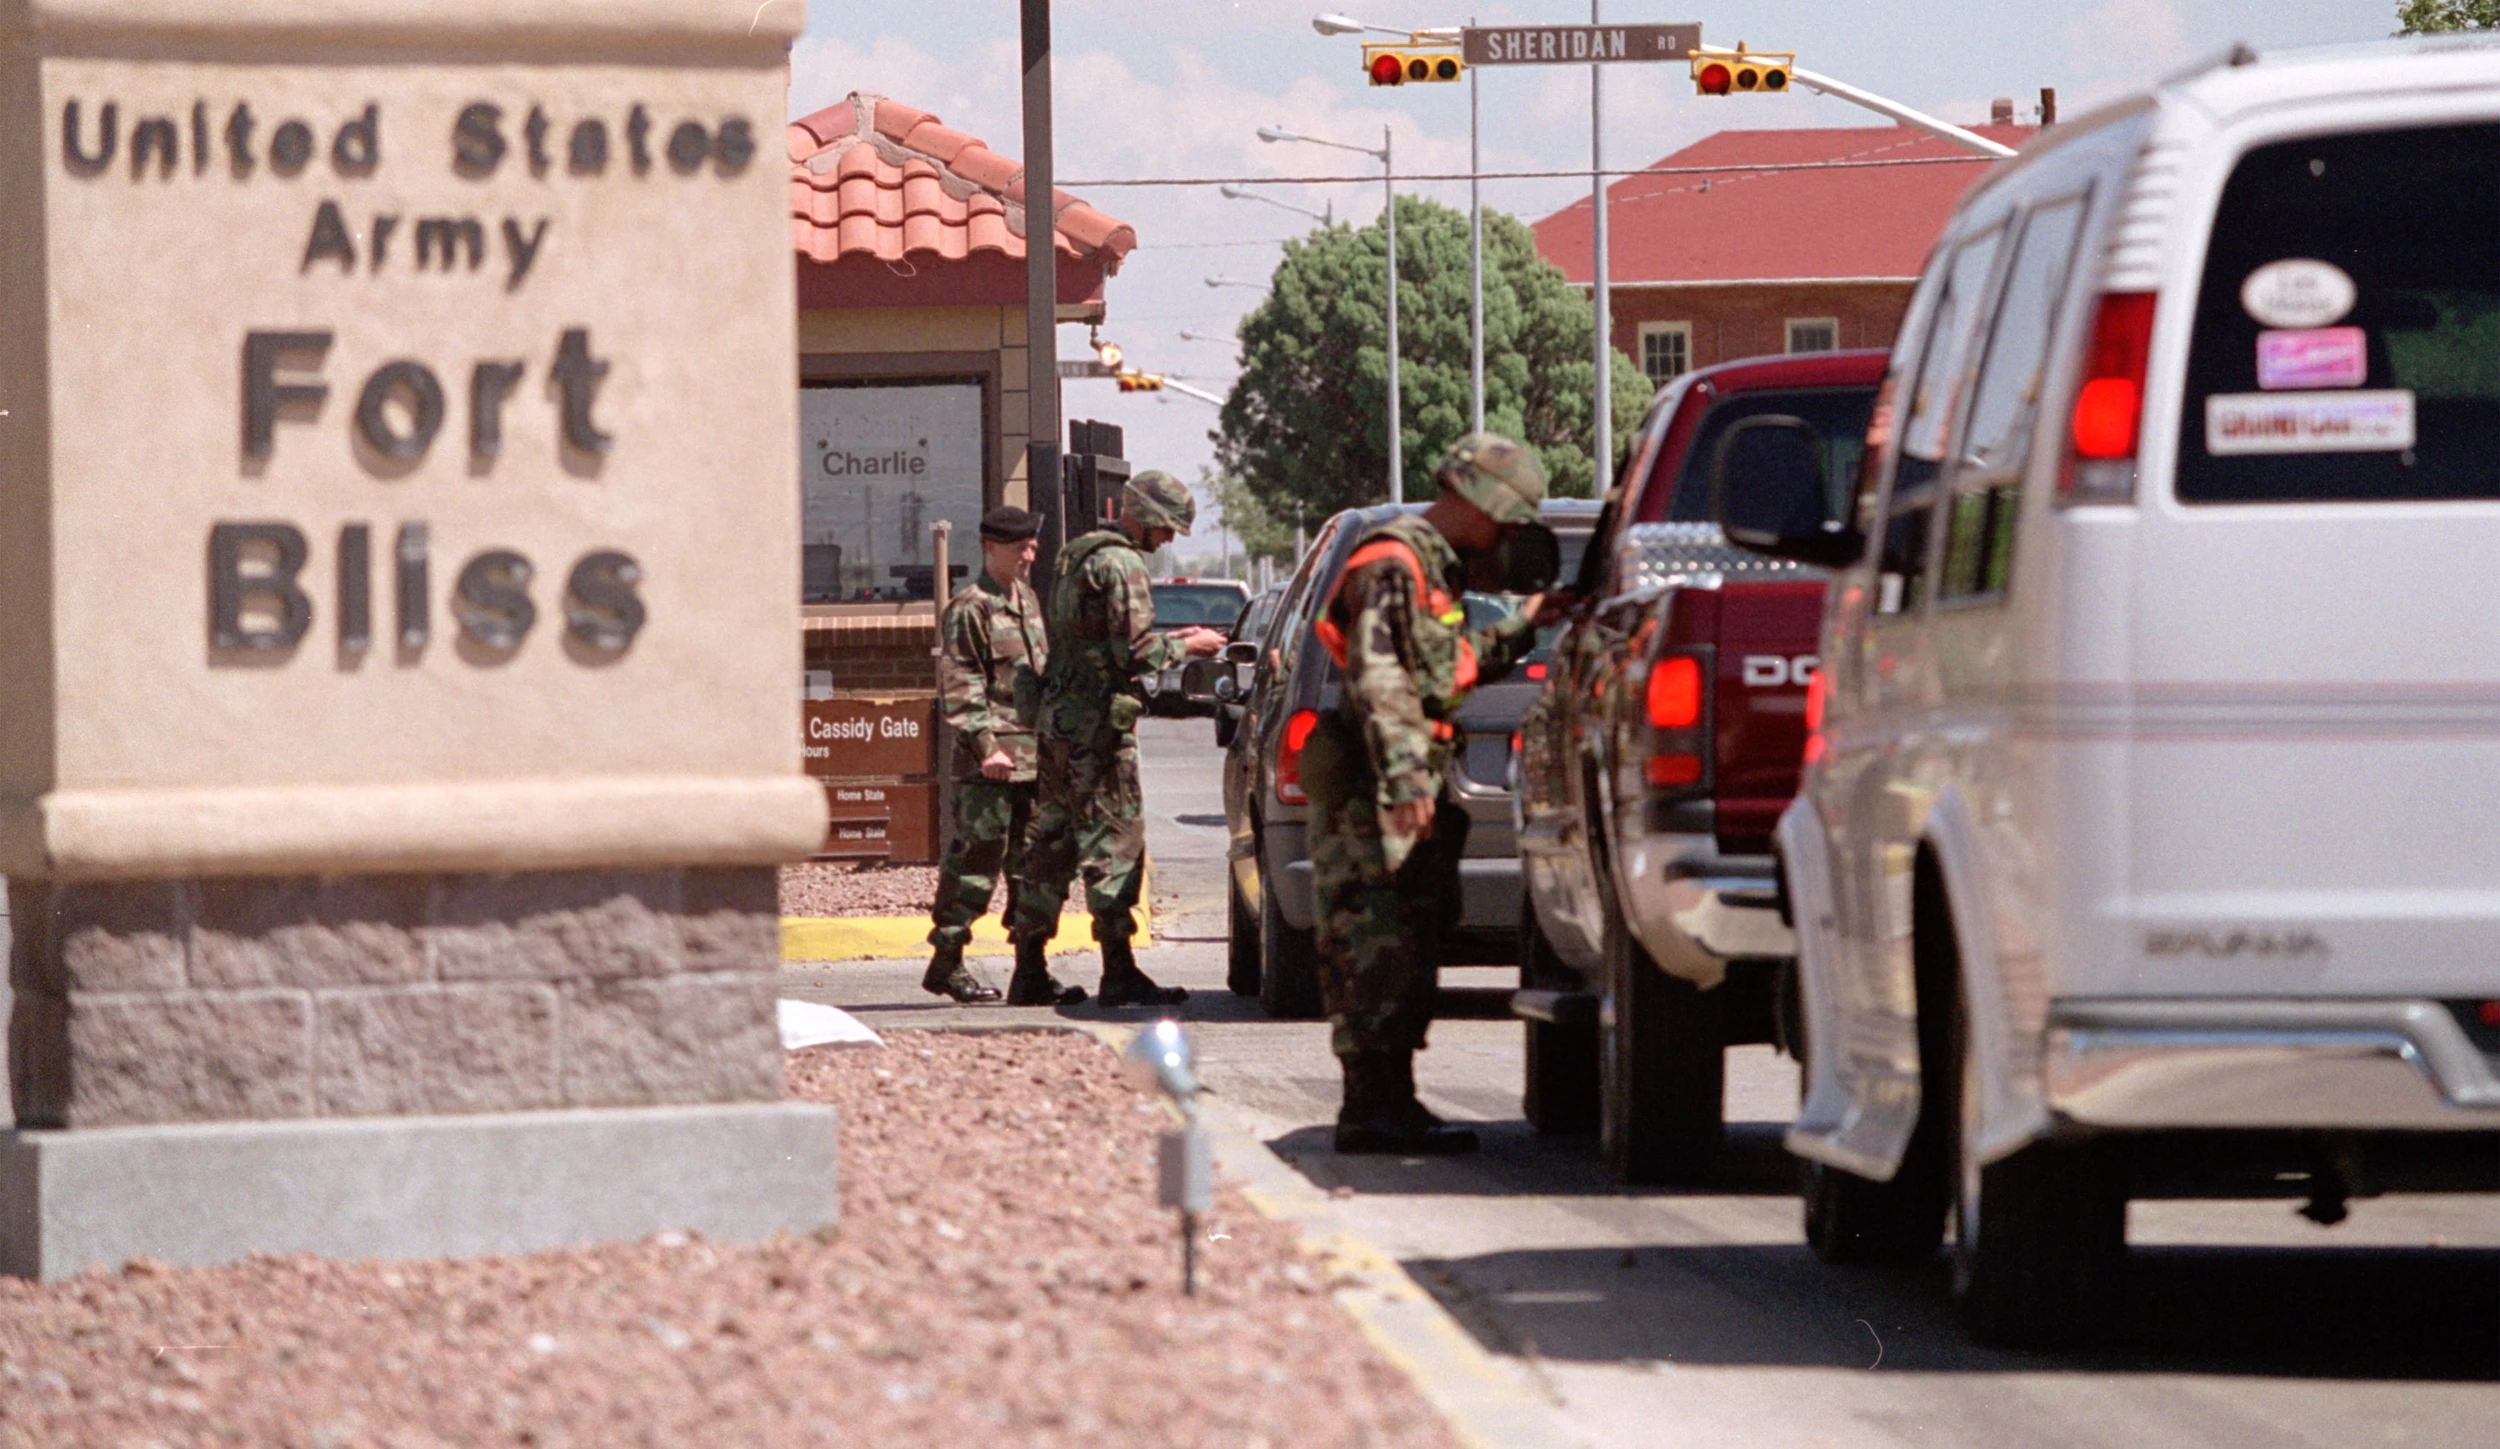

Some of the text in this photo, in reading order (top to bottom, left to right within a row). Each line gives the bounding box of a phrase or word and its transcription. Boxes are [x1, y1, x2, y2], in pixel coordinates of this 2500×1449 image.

[1488, 30, 1676, 60] SHERIDAN RD
[61, 99, 759, 180] United States
[300, 200, 550, 292] Army
[240, 327, 614, 472] Fort
[822, 451, 926, 476] Charlie
[207, 521, 648, 664] Bliss
[810, 716, 919, 742] Cassidy Gate
[837, 789, 862, 801] Home
